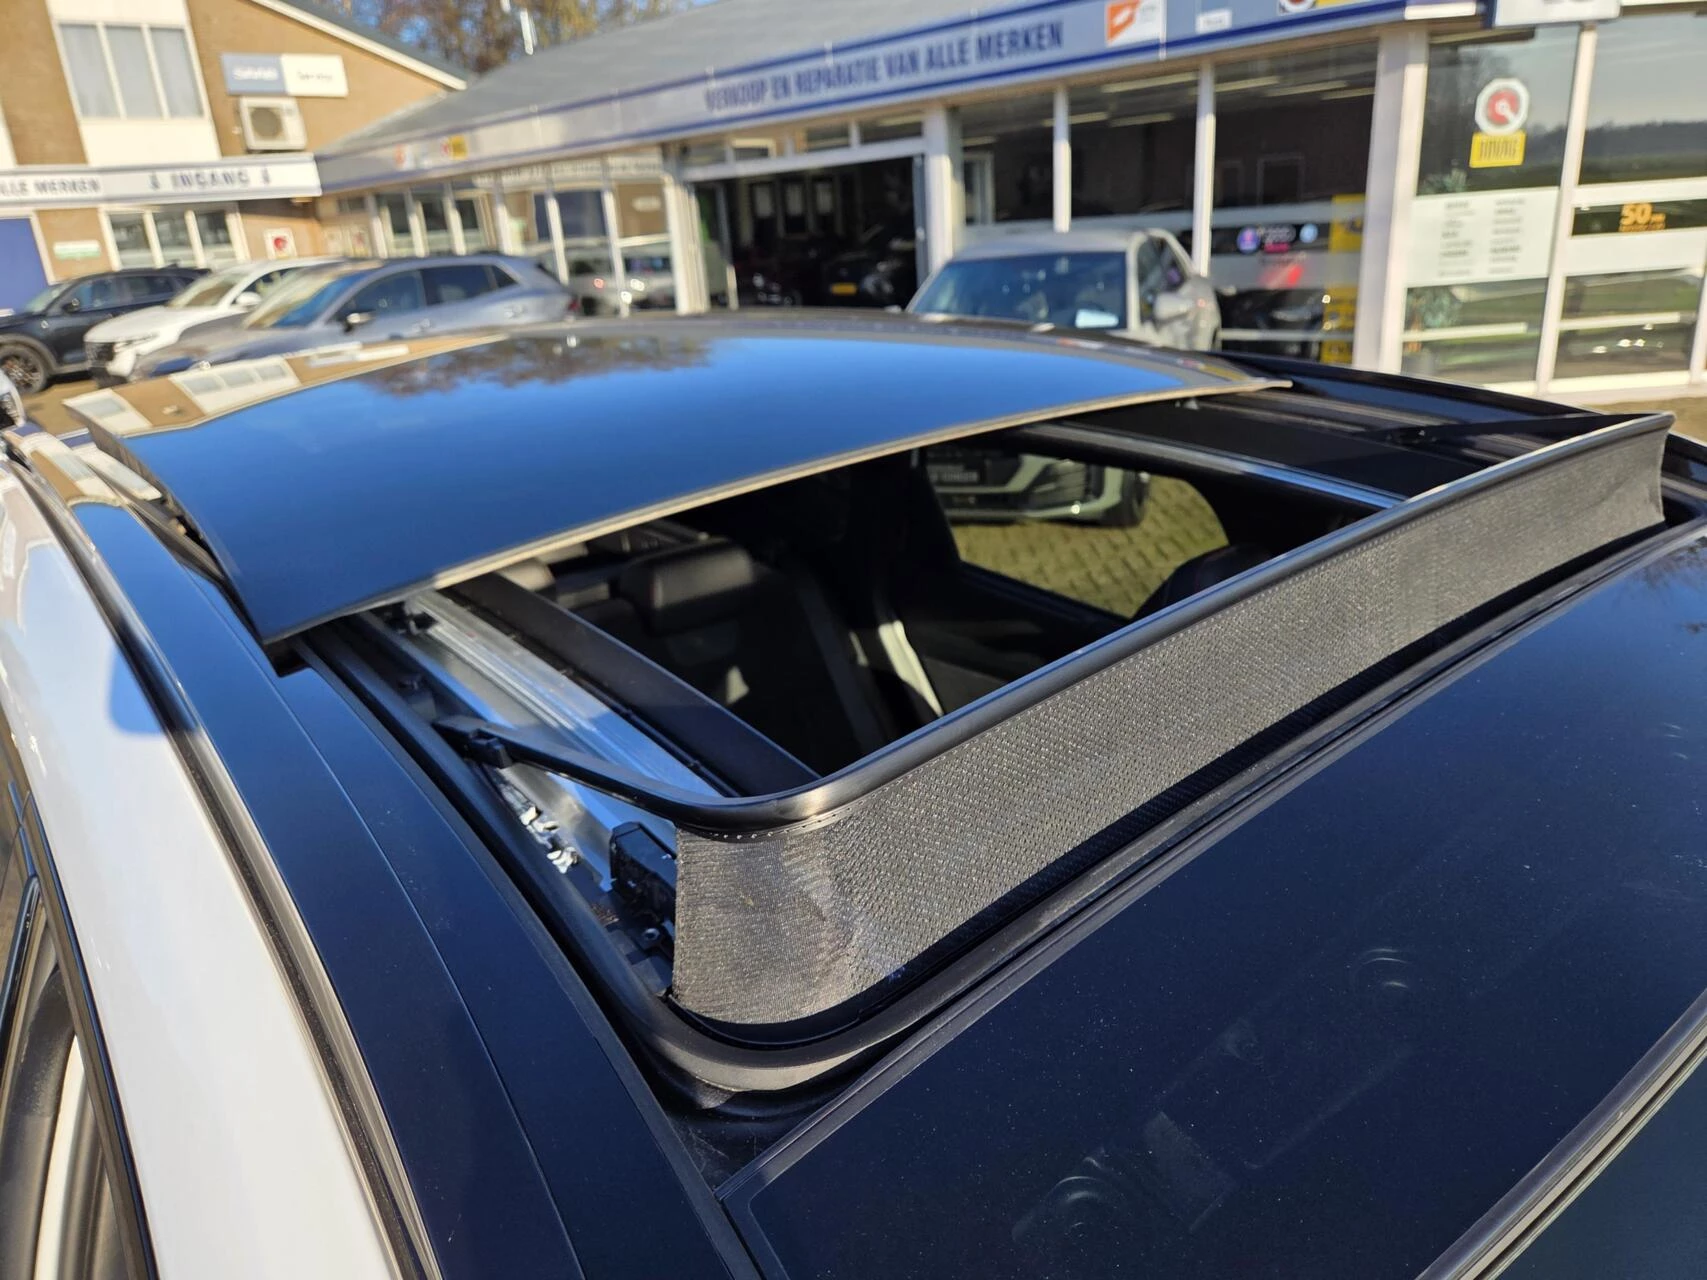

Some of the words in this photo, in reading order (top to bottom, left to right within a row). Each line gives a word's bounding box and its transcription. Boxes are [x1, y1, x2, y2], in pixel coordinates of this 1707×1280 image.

[772, 75, 792, 100] EN
[796, 57, 878, 94] REPARATIE
[883, 47, 920, 79] VAN
[925, 39, 970, 71] ALLE
[975, 20, 1063, 62] MERKEN
[1620, 203, 1652, 225] 50
